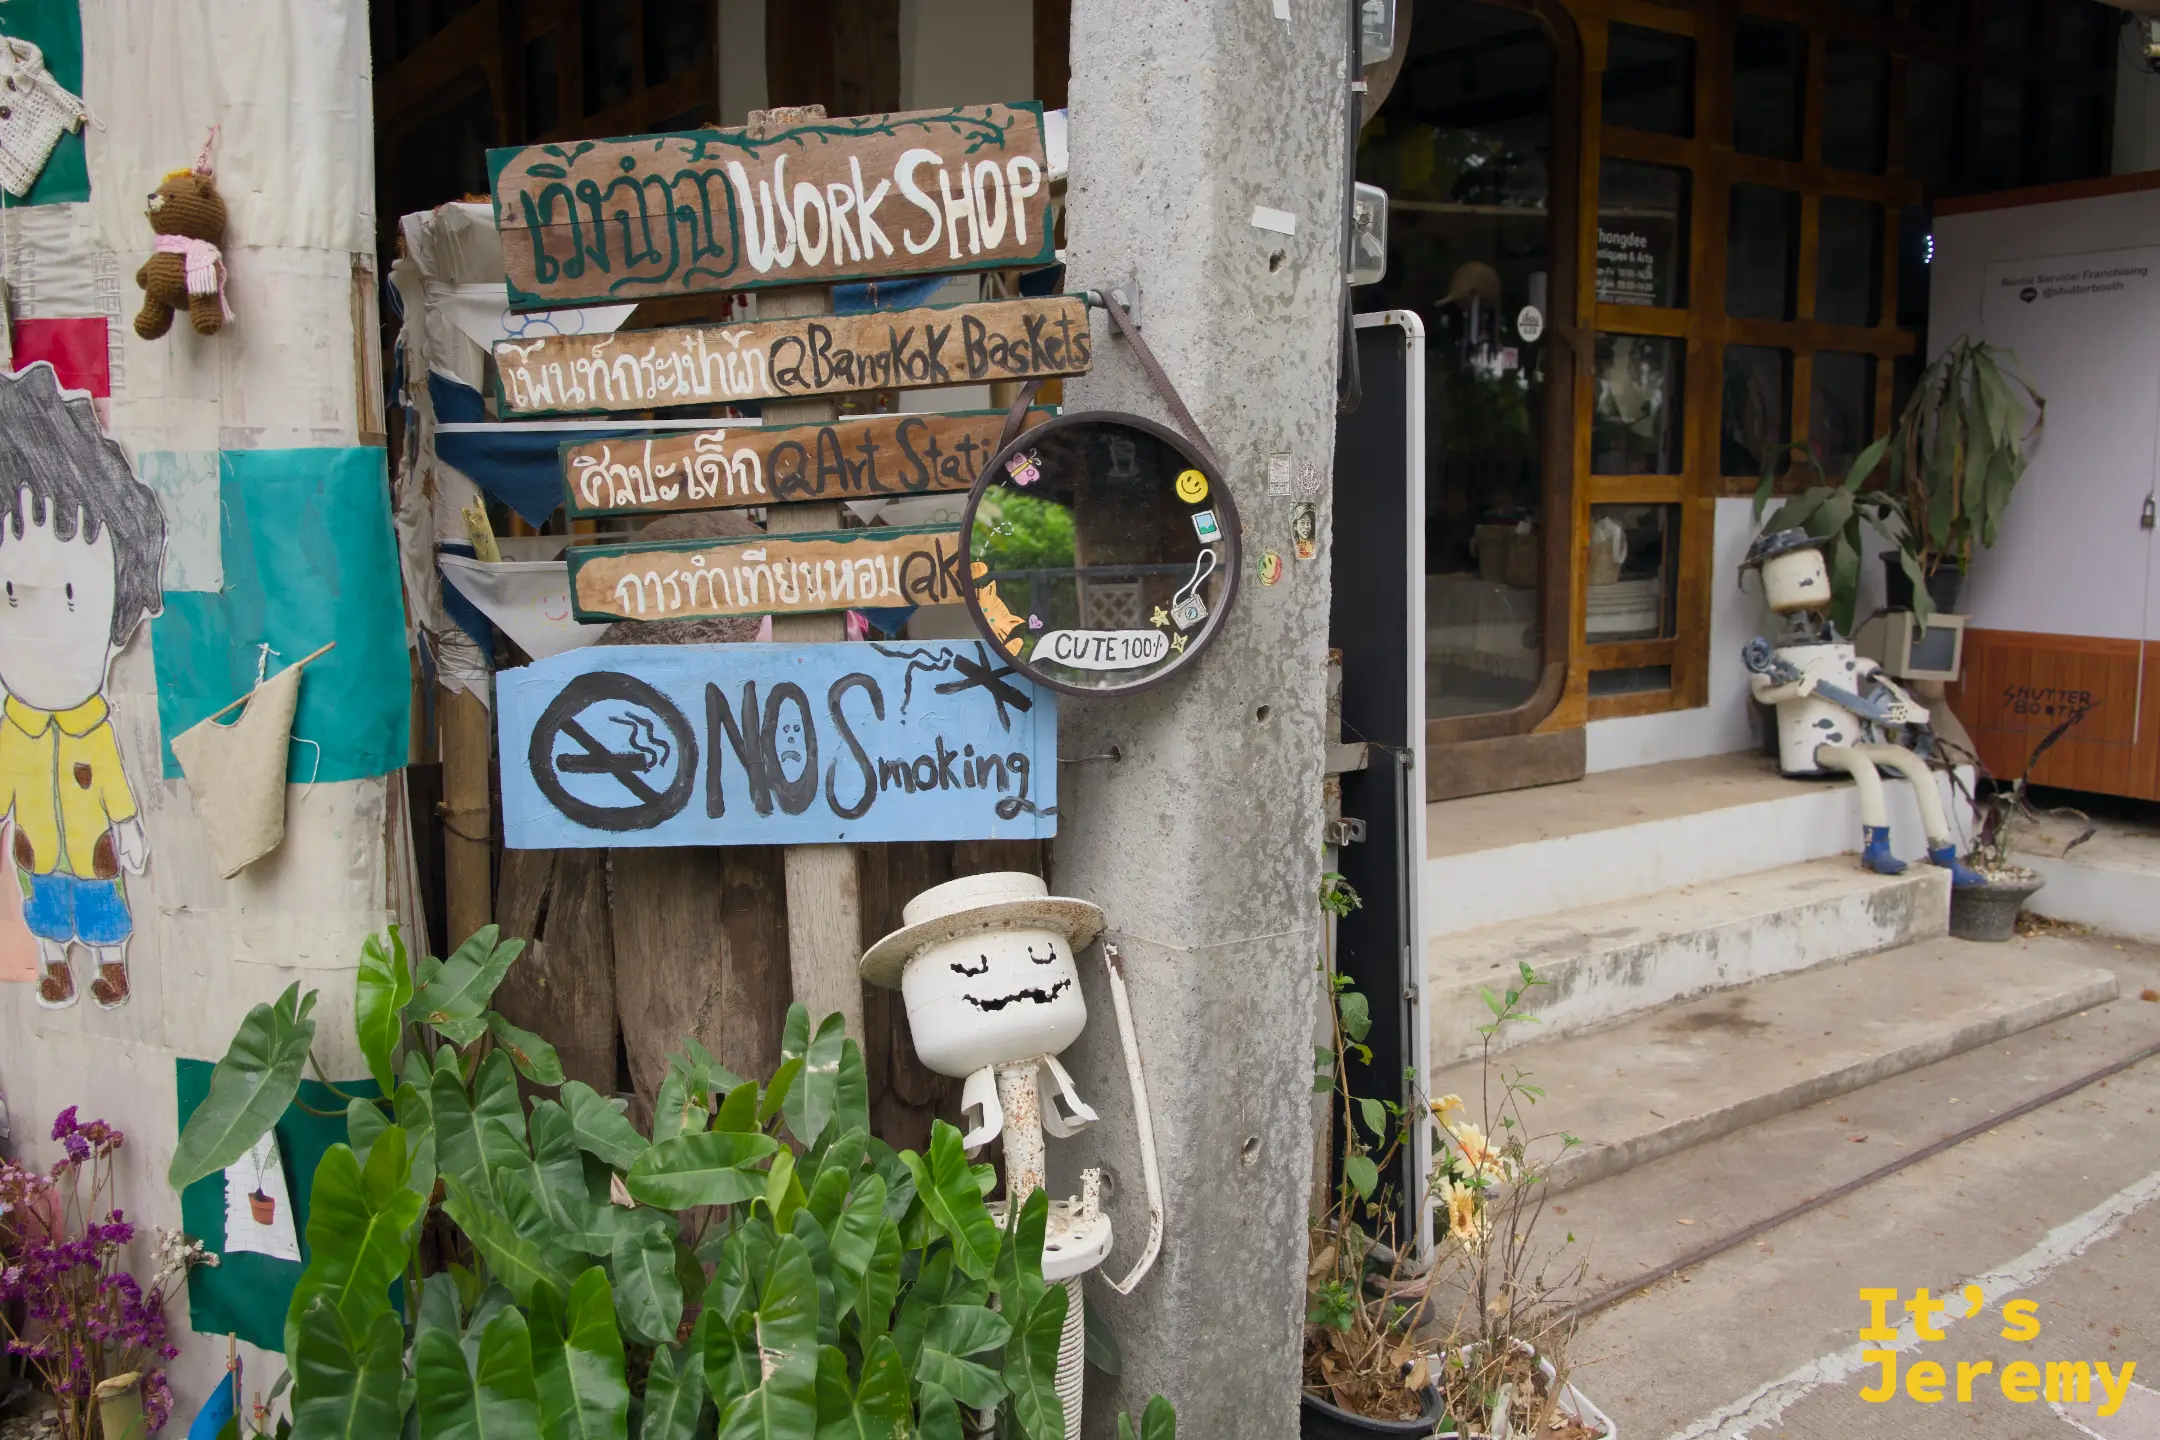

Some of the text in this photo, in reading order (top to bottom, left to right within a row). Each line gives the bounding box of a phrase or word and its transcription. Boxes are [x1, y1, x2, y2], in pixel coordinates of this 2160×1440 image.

[573, 429, 766, 509] ศิลปะเด็ก
[896, 418, 992, 491] Stati
[615, 548, 902, 614] การทำเทียนหอม
[1055, 633, 1162, 661] CUTE 100%
[2003, 683, 2091, 708] SHUTTER
[705, 672, 1057, 820] NO Smoking
